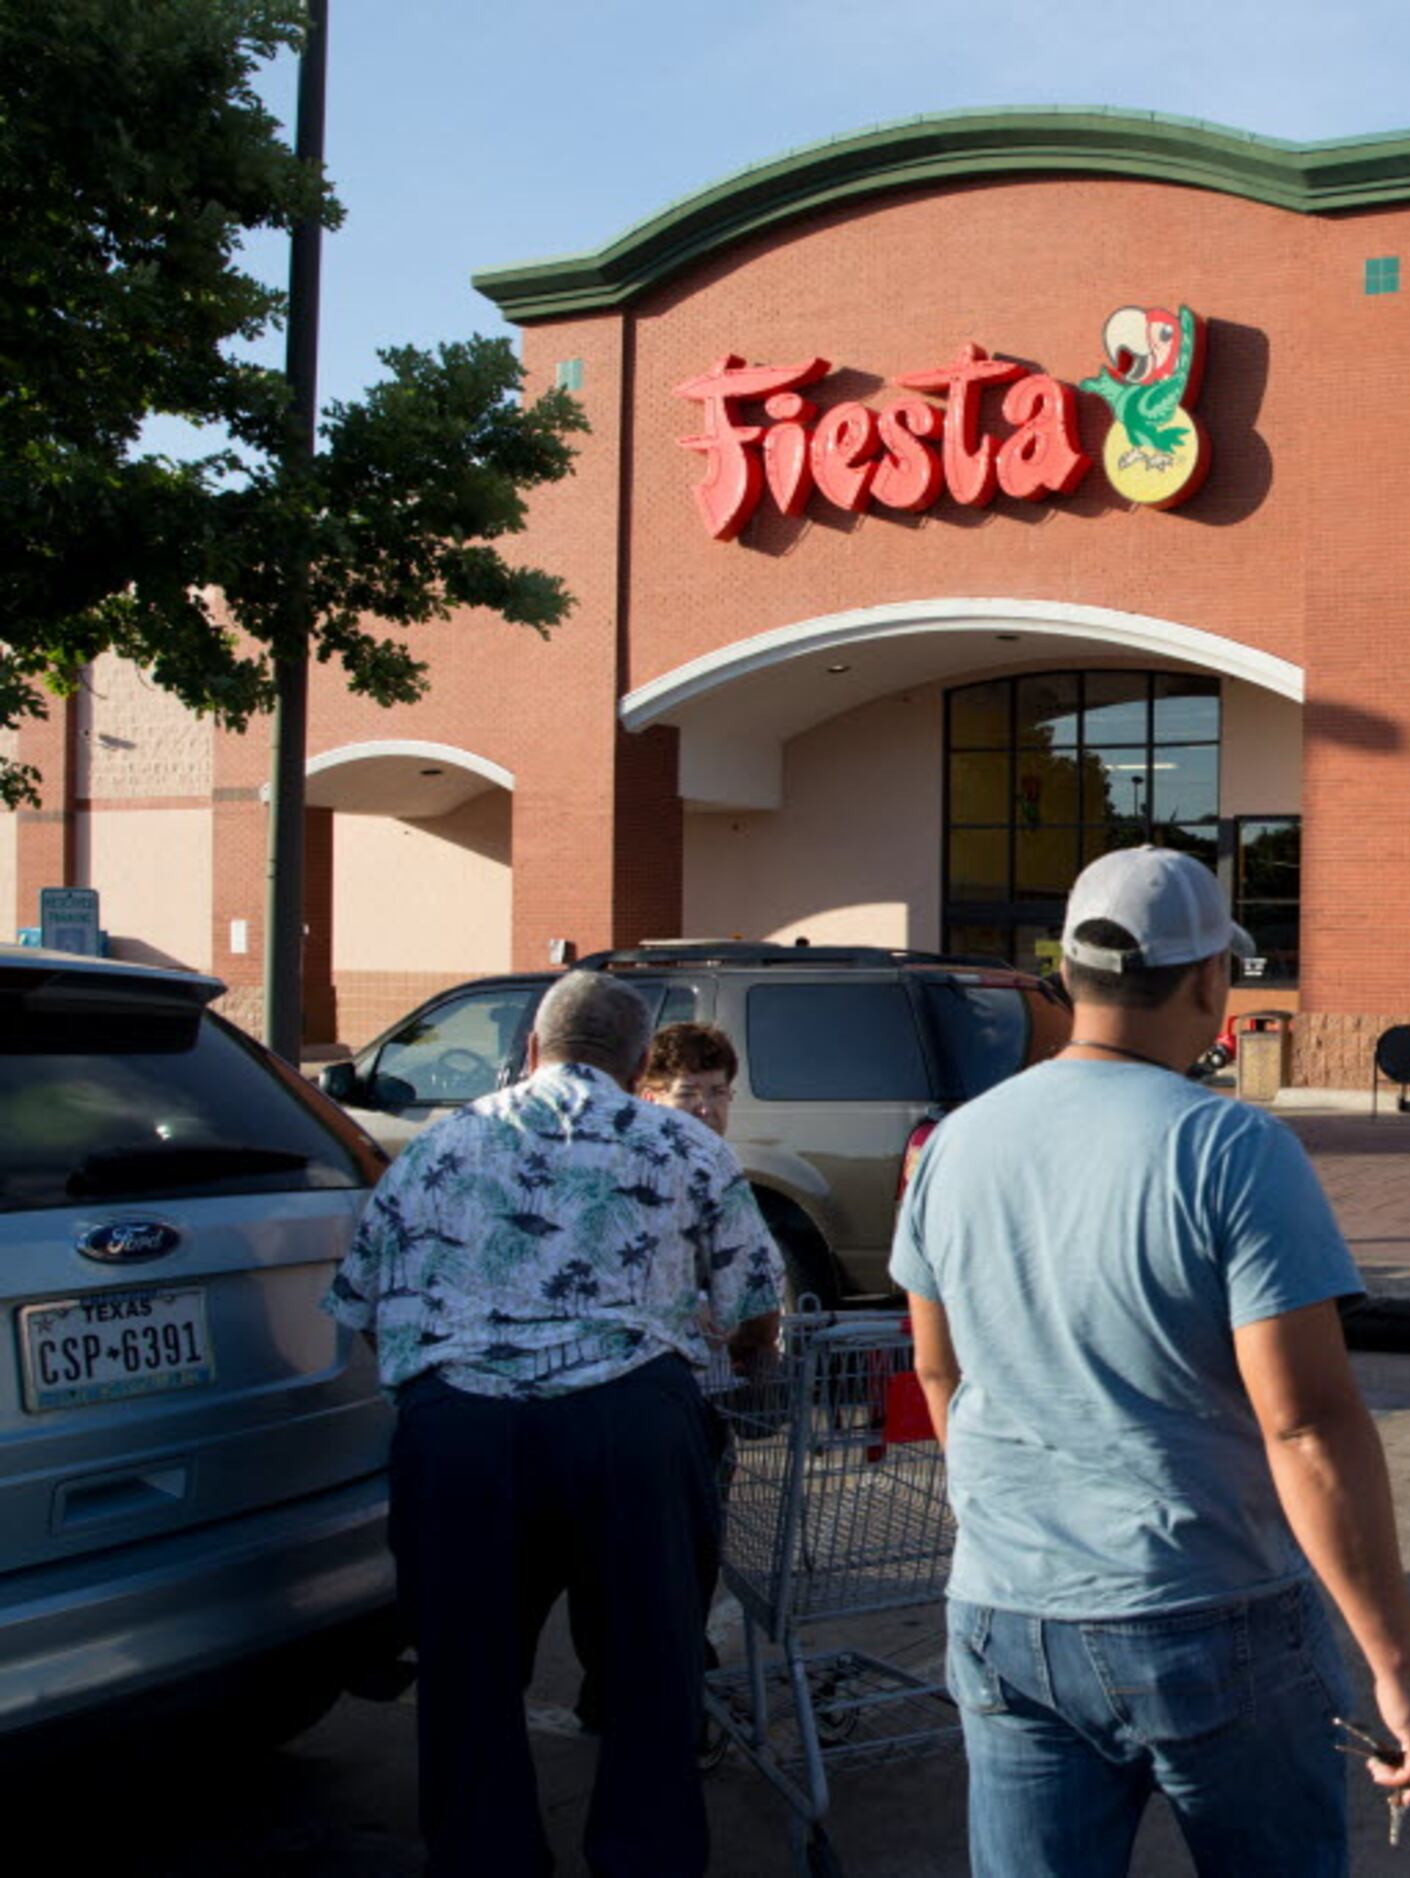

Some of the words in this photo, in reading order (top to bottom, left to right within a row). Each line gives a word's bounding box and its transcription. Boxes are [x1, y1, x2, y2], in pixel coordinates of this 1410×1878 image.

[673, 343, 1091, 541] Fiesta
[107, 1225, 164, 1254] Ford
[82, 1299, 152, 1322] TEXAS
